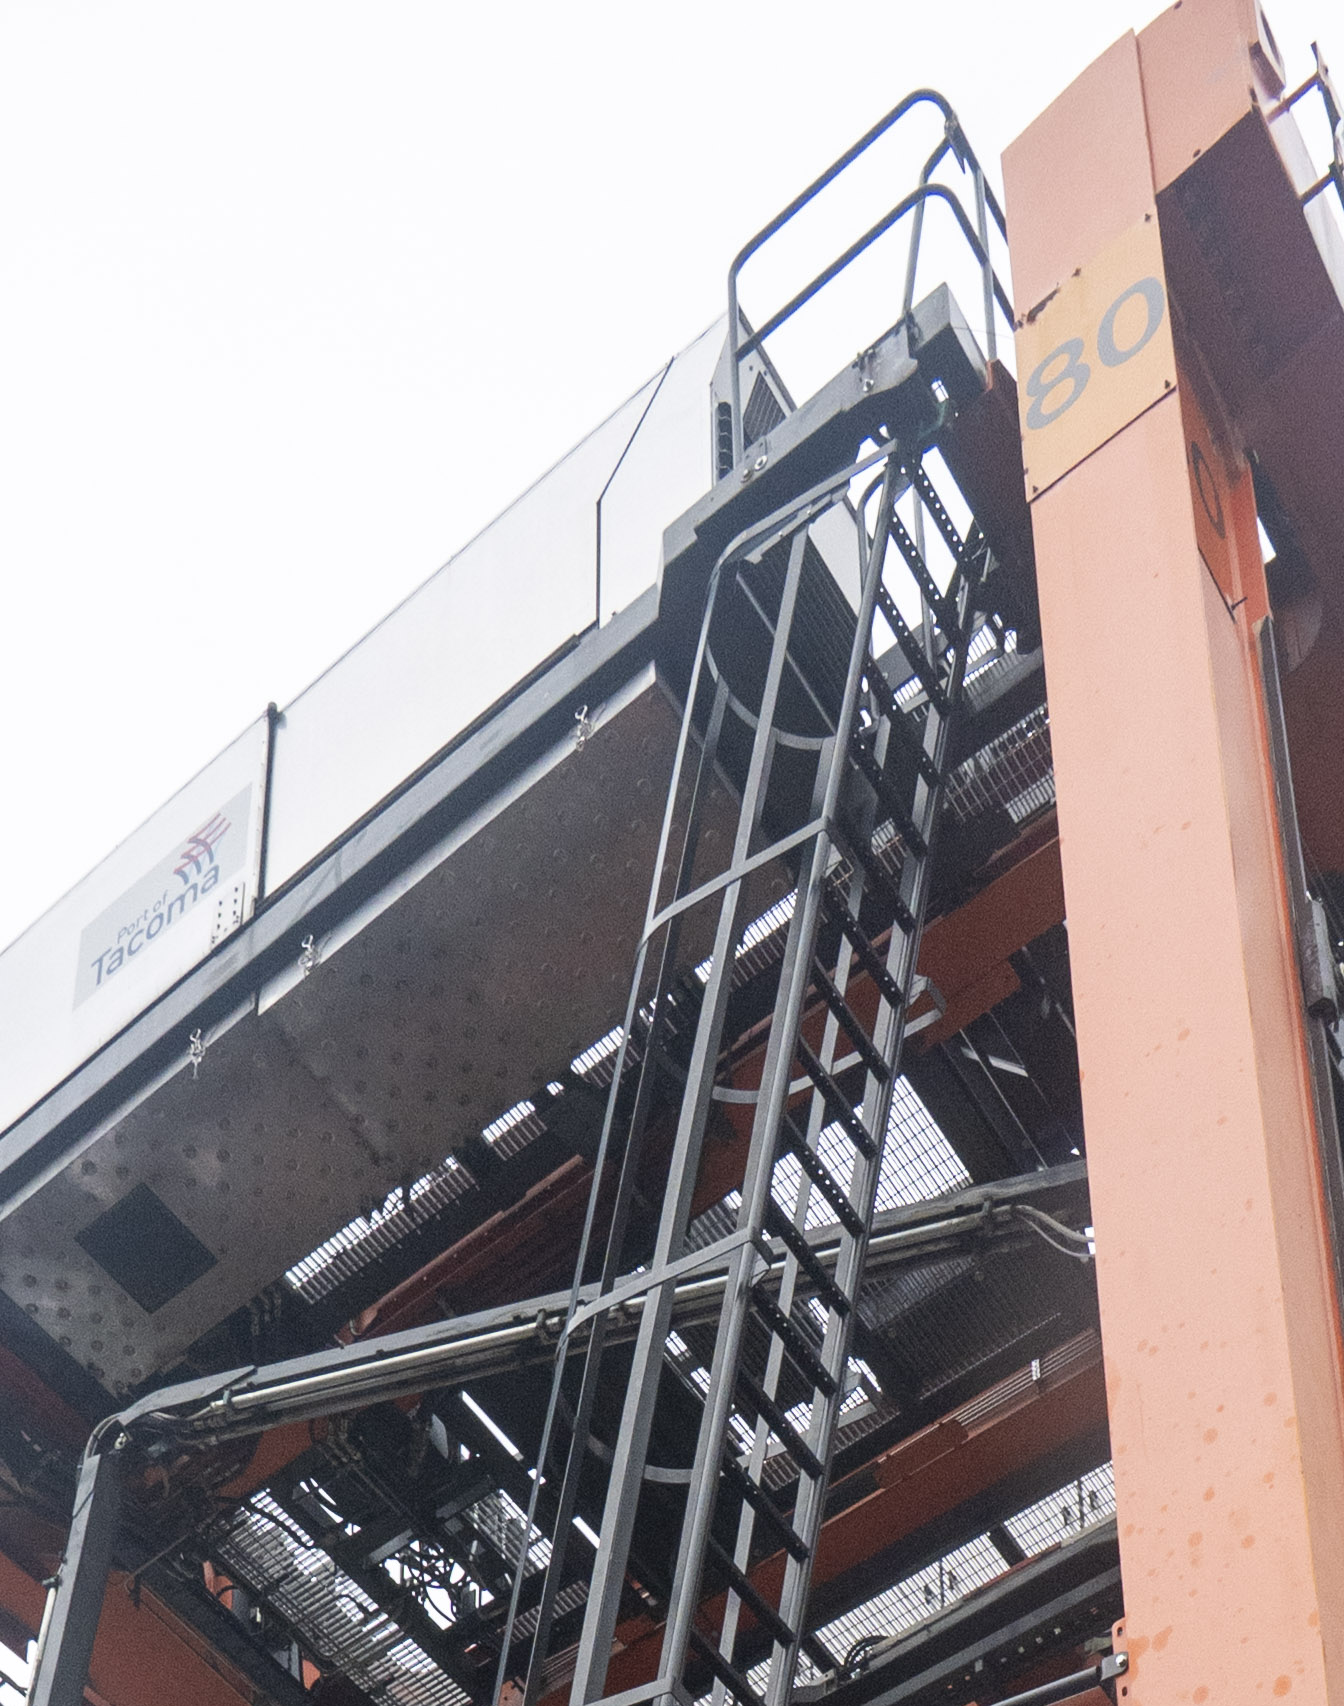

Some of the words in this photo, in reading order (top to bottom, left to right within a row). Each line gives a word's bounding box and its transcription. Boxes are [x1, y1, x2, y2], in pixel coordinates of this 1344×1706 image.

[1024, 276, 1168, 432] 80
[91, 864, 220, 985] Tacoma
[117, 909, 148, 944] Port
[153, 889, 168, 912] of
